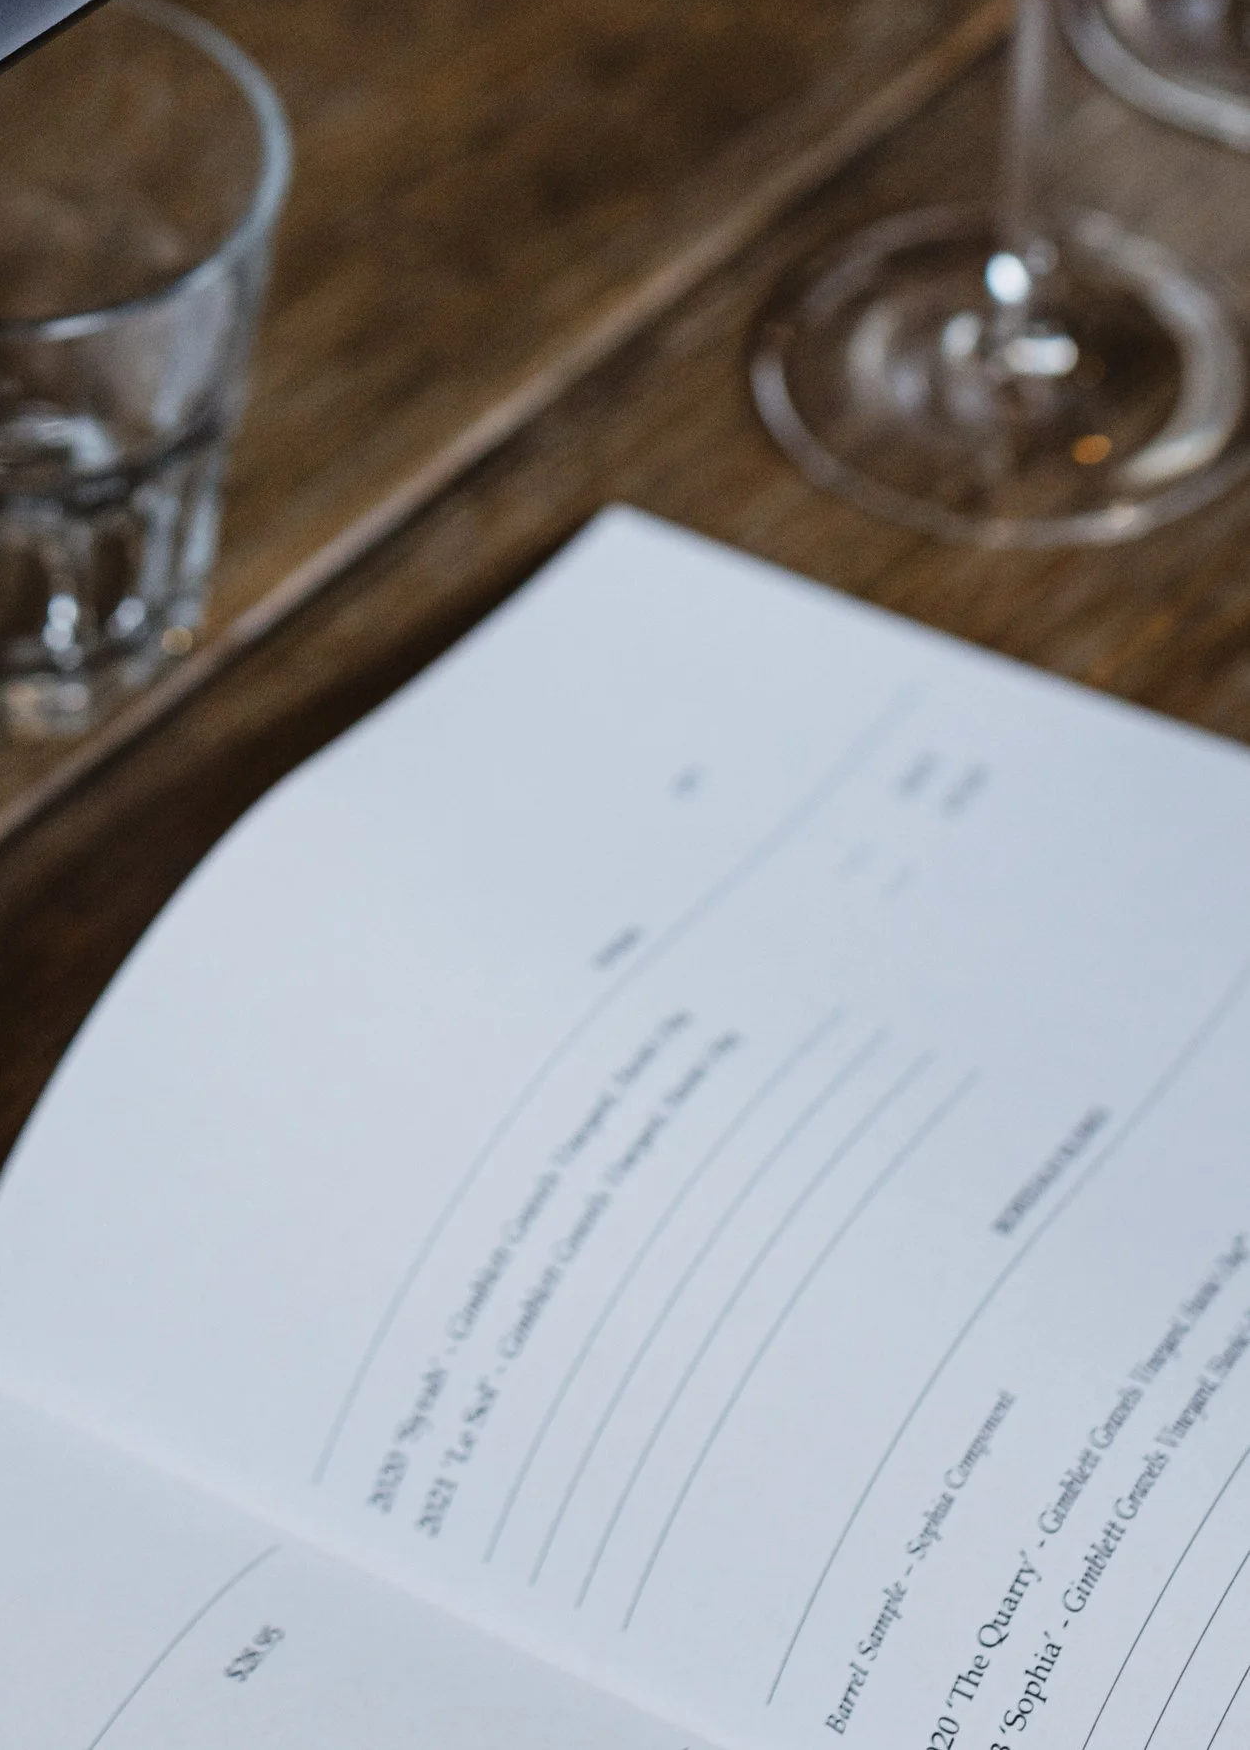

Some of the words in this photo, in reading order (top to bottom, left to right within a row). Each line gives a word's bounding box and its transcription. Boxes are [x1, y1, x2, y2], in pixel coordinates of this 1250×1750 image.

[825, 1663, 869, 1736] Barrel
[857, 1581, 908, 1661] Sample
[906, 1492, 956, 1563] Sophia
[946, 1653, 991, 1709] 'The
[978, 1549, 1042, 1651] Quarry'
[1038, 1448, 1102, 1536] Gimblett
[999, 1629, 1063, 1735] 'Sophia'
[1062, 1519, 1126, 1614] Gimblett
[1113, 1448, 1170, 1523] Gravels
